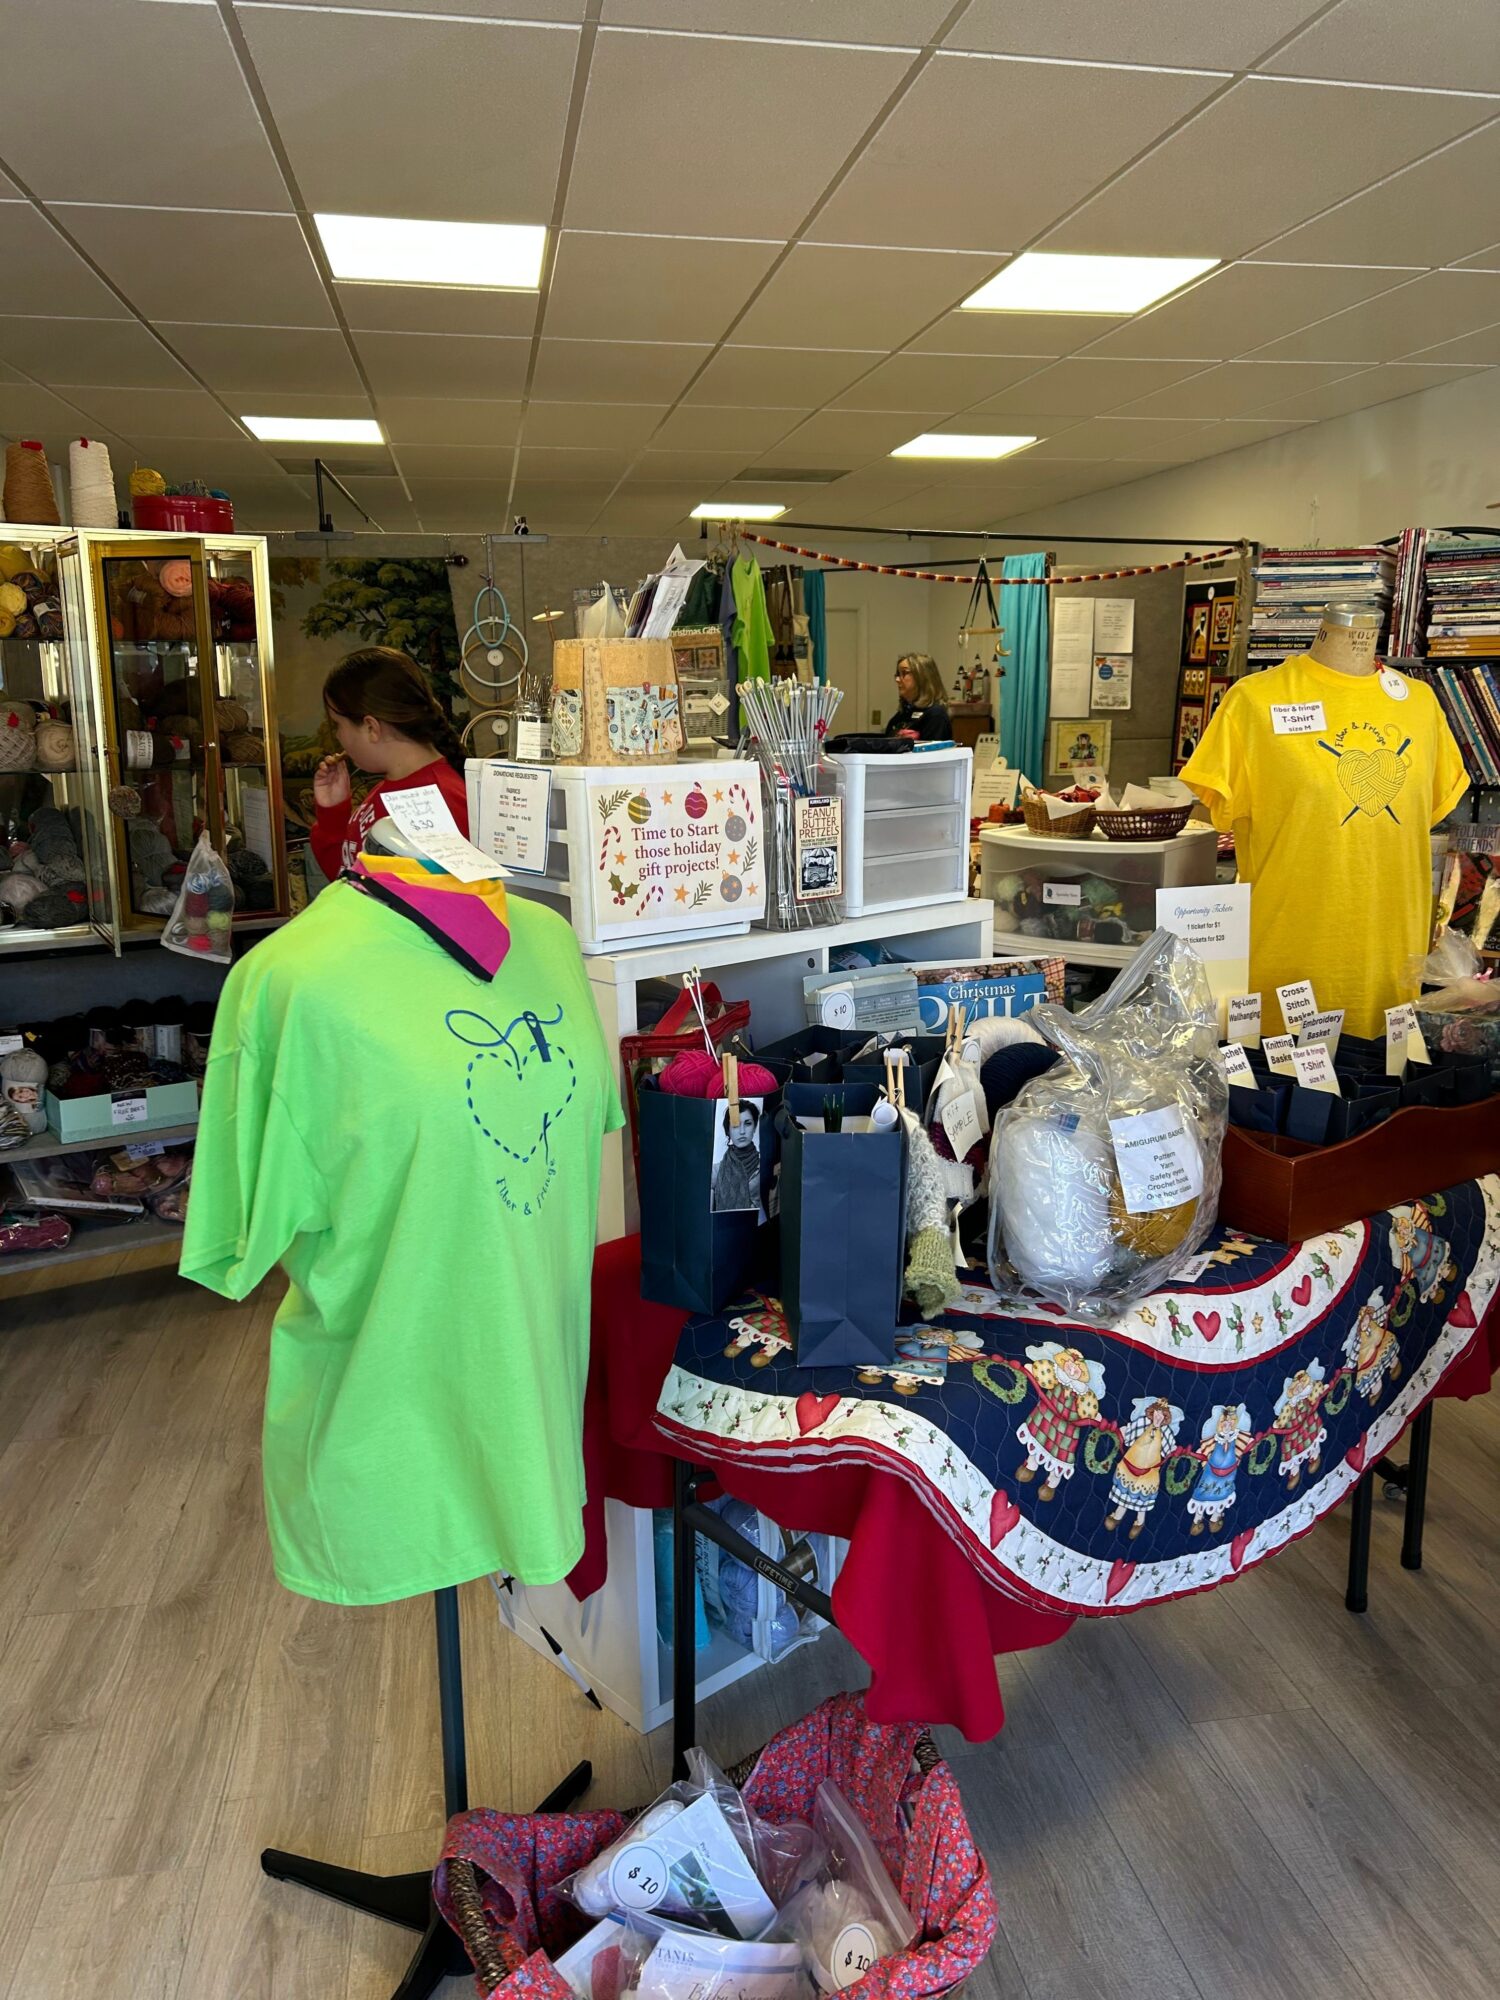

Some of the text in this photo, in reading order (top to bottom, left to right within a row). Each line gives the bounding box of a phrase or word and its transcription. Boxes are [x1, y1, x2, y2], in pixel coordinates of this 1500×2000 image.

[670, 625, 721, 637] hristmas Gifts
[1348, 631, 1376, 640] WOLF
[1298, 704, 1320, 712] fringe
[1282, 714, 1314, 723] T-Shirt
[1335, 722, 1386, 748] Fiber & Fringe
[493, 770, 538, 780] DONATIONS REQUESTED
[802, 807, 836, 818] PEANUT
[802, 817, 836, 828] BUTTER
[632, 824, 720, 842] Time to Start
[800, 826, 840, 839] PRETZELS
[634, 840, 722, 860] those holiday
[1456, 838, 1494, 852] FRIENDS
[638, 858, 720, 881] gift projects!
[1174, 904, 1233, 919] Opportunity Tickets
[1216, 934, 1224, 942] $20
[948, 984, 1016, 1000] Christmas
[1282, 986, 1308, 998] Cross-
[1232, 998, 1258, 1009] Peg-Loom
[1286, 998, 1310, 1011] Stitch
[834, 1004, 847, 1016] $ 10
[1229, 1010, 1261, 1022] Wallhanging
[1302, 1014, 1342, 1029] Embroidery
[1390, 1017, 1405, 1027] Antique
[1307, 1028, 1330, 1040] Basket
[1392, 1031, 1402, 1042] Quilt
[1265, 1038, 1294, 1050] Knitting
[1222, 1047, 1244, 1060] ochet
[1270, 1054, 1292, 1064] Baske
[1226, 1061, 1247, 1074] asket
[1301, 1060, 1326, 1072] T-Shirt
[1309, 1076, 1320, 1084] size
[947, 1110, 974, 1142] SAMPLE
[1124, 1134, 1167, 1148] AMIGURUMI
[1154, 1152, 1176, 1162] Pattern
[1160, 1162, 1174, 1170] Yarn
[1150, 1168, 1184, 1182] Safety eyes
[496, 1158, 556, 1215] Fiber & Fringe
[1148, 1176, 1188, 1190] Crochet hook
[1180, 1184, 1192, 1192] class
[758, 1560, 794, 1589] LIFETIME
[628, 1866, 659, 1895] $ 10
[658, 1948, 694, 1961] TANIS
[844, 1950, 870, 1972] $ 10
